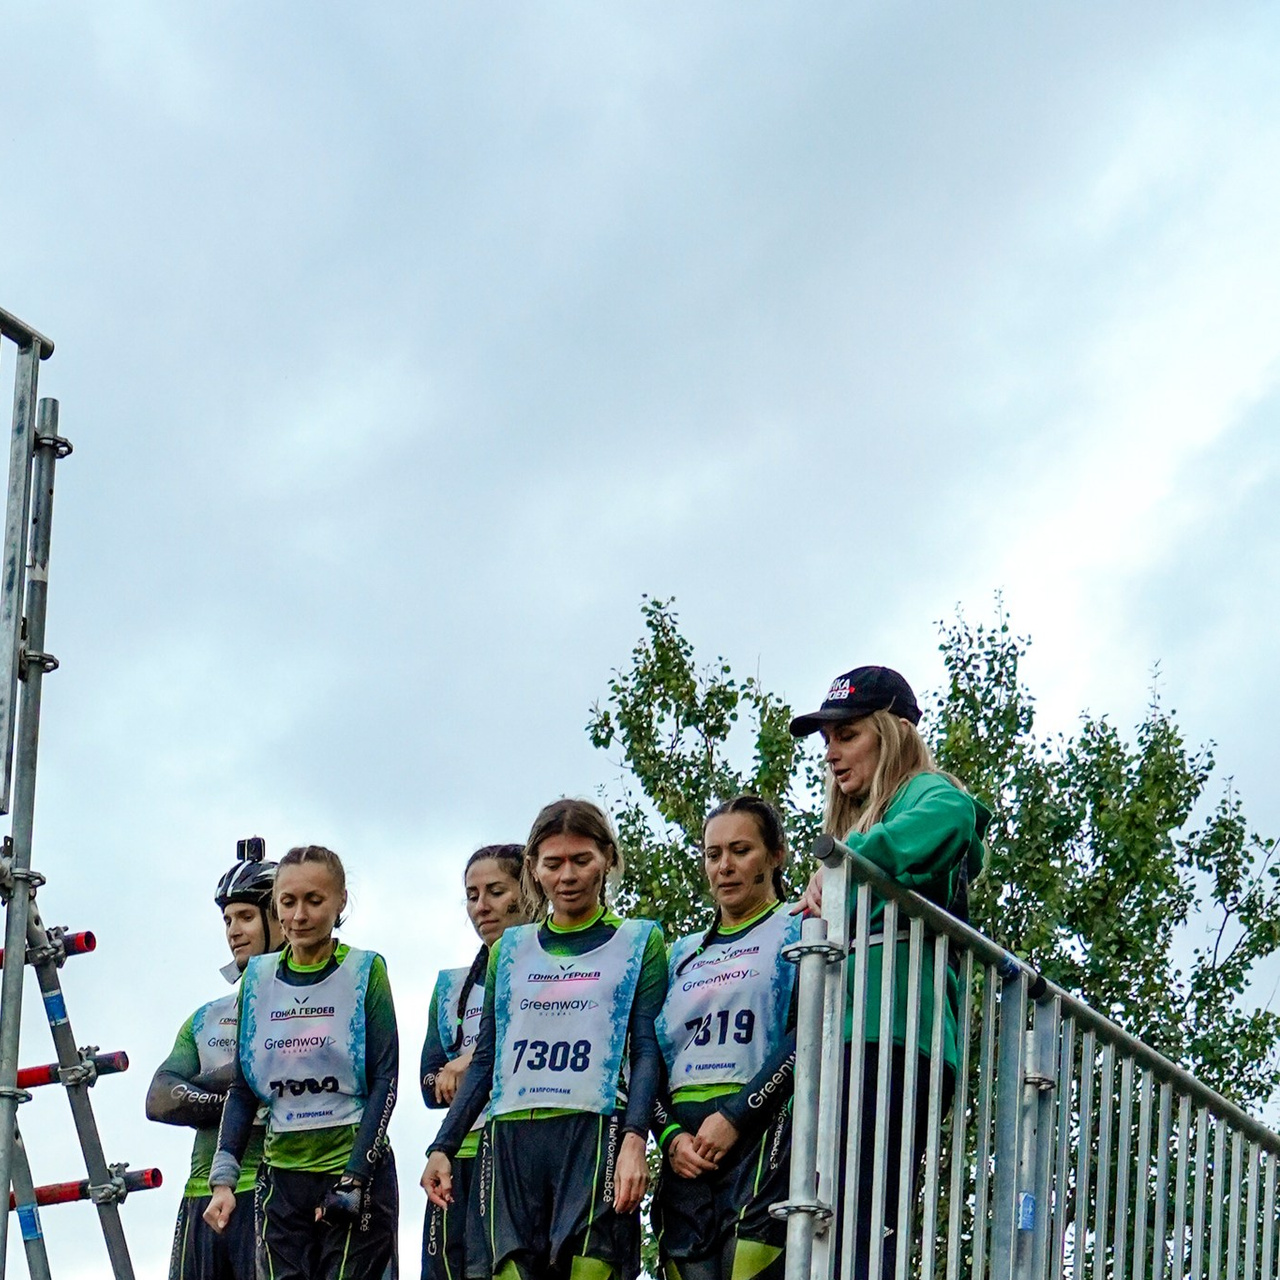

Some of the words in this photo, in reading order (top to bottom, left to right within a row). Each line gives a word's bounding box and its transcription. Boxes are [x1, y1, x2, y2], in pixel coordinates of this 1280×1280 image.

[528, 973, 560, 981] ГОНКА
[563, 971, 601, 979] ГЕРОЕВ
[682, 969, 750, 992] Greenway
[520, 998, 589, 1011] Greenway
[270, 1008, 297, 1019] ГОНКА
[299, 1006, 335, 1016] ГЕРОЕВ
[466, 1006, 483, 1017] ГОН
[207, 1037, 237, 1048] Green
[264, 1036, 327, 1050] Greenway
[513, 1039, 592, 1074] 7308
[747, 1050, 796, 1110] Greenw
[529, 1087, 572, 1095] ГАЗПРОМБАНК
[366, 1086, 396, 1164] Greenway
